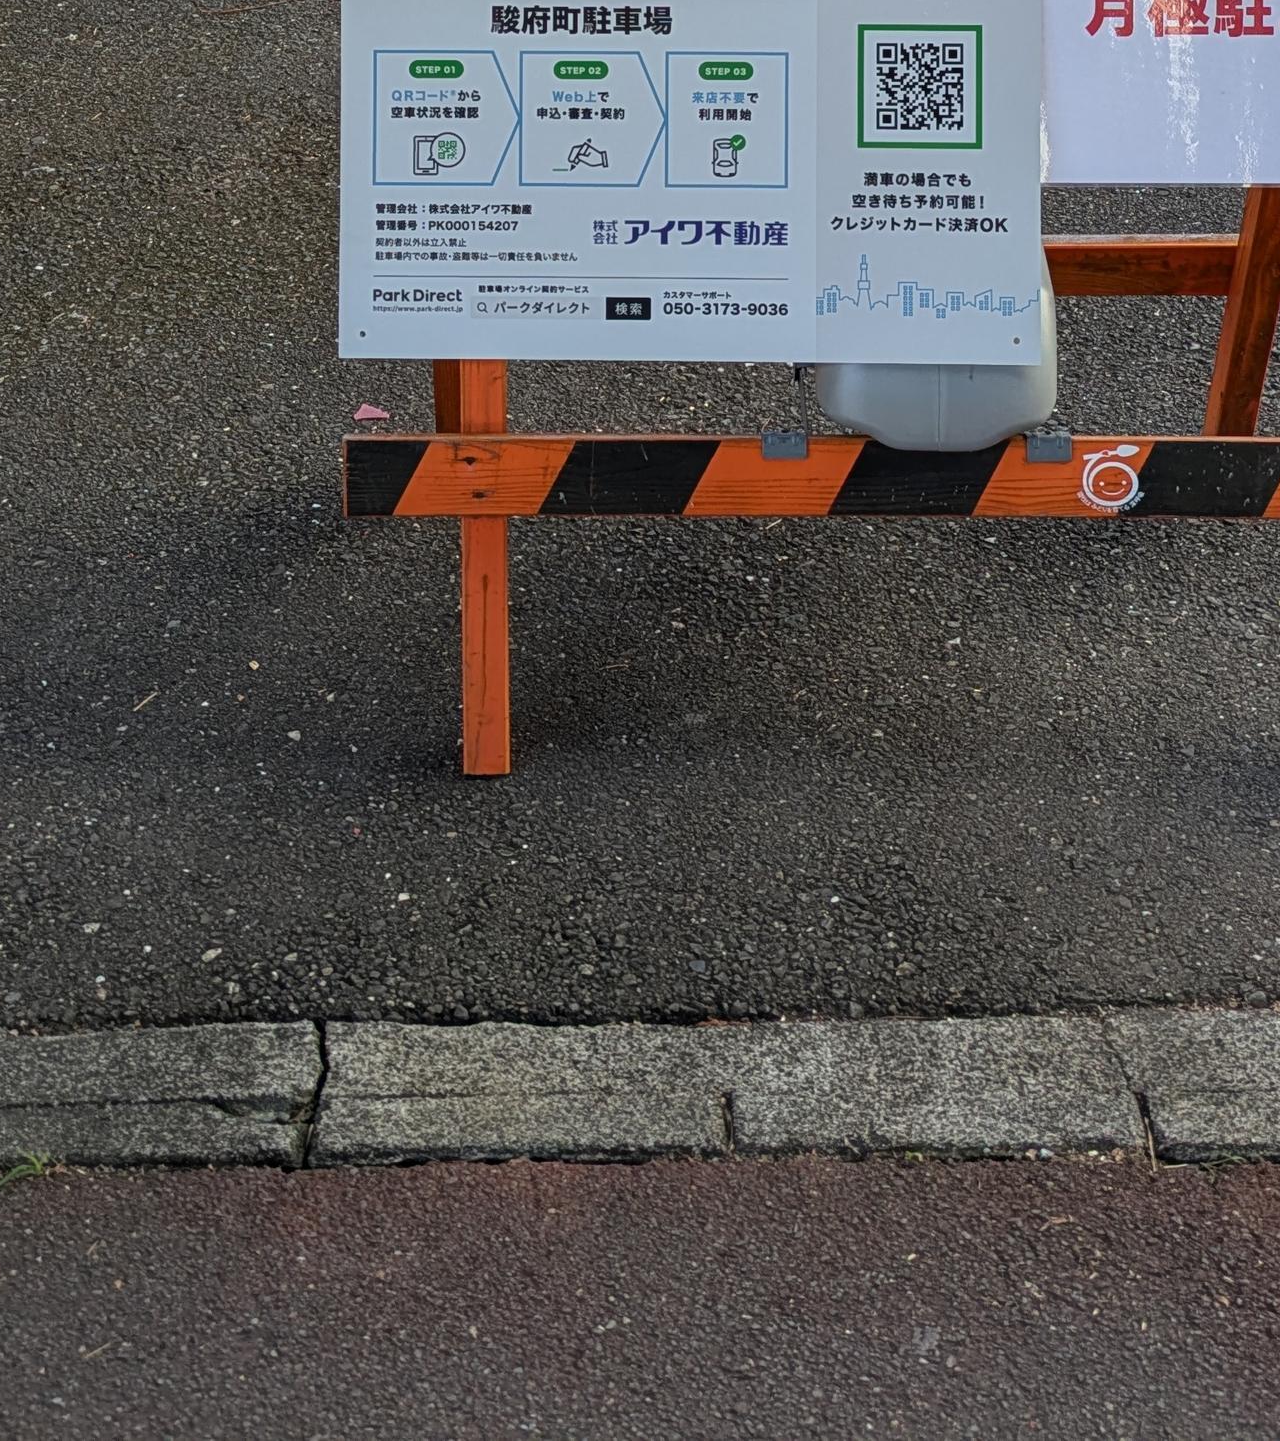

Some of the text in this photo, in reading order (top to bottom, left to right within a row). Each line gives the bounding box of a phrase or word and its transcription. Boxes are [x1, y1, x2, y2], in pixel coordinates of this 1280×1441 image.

[491, 5, 672, 35] 駿府町駐車場
[415, 65, 457, 75] STEP 01
[559, 66, 602, 75] STEP 02
[704, 67, 747, 76] STEP 03
[553, 91, 609, 102] Web上で
[692, 92, 759, 103] 来店不要で
[391, 107, 478, 118] 空車状況を確認
[537, 108, 624, 119] 申込・審査・契約
[699, 109, 751, 120] 利用開始
[864, 172, 971, 187] 満車の場合でも
[593, 220, 618, 232] 株式
[831, 217, 1008, 232] クレジットカード決済OK
[624, 220, 788, 245] アイワ不動産
[376, 238, 466, 247] 契約者以外は立入禁止
[593, 233, 618, 244] 会社
[479, 285, 588, 293] 駐車場オンライン契約サービス
[373, 289, 462, 301] Park Direct
[664, 291, 731, 299] カスタマーサポート
[494, 302, 589, 313] パークダイレクト
[615, 303, 642, 315] 検索
[664, 303, 788, 315] 050-3173-9036
